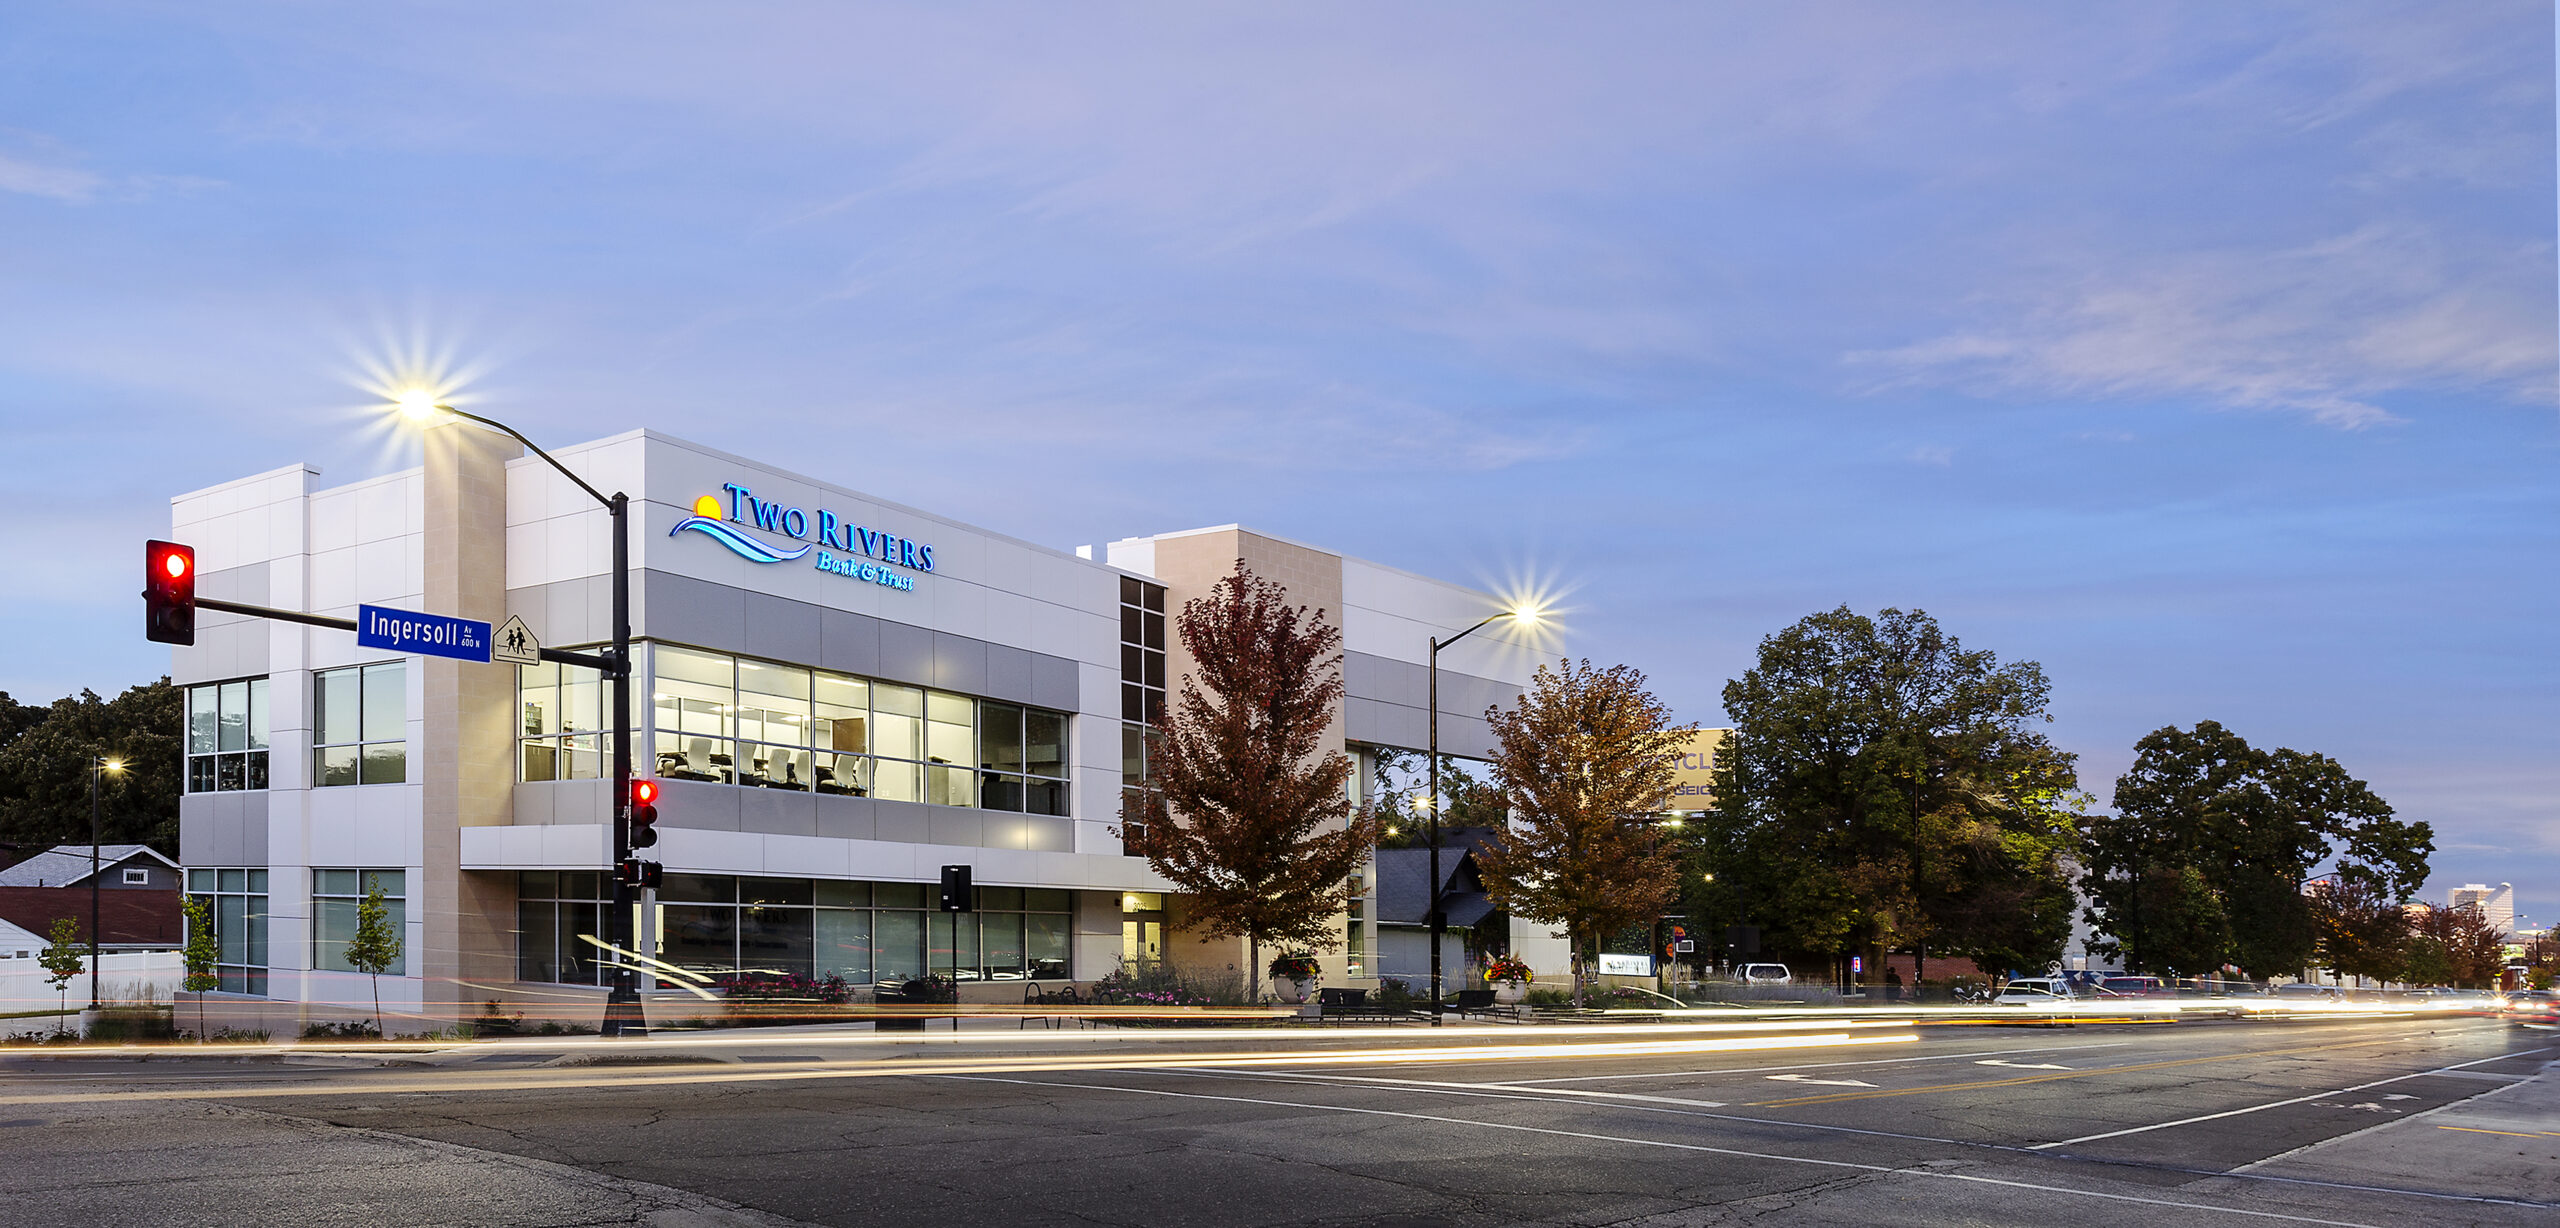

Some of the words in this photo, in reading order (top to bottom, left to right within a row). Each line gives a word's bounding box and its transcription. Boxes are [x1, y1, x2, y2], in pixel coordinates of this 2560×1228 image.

[723, 482, 809, 539] TWO
[817, 508, 935, 573] RIVERS
[816, 550, 857, 580] Bank
[858, 562, 876, 581] &
[876, 564, 914, 592] Trust
[370, 611, 457, 646] Ingersoll
[463, 625, 473, 634] Av
[461, 638, 474, 648] 600
[475, 640, 480, 648] N
[1674, 785, 1712, 796] GEIC
